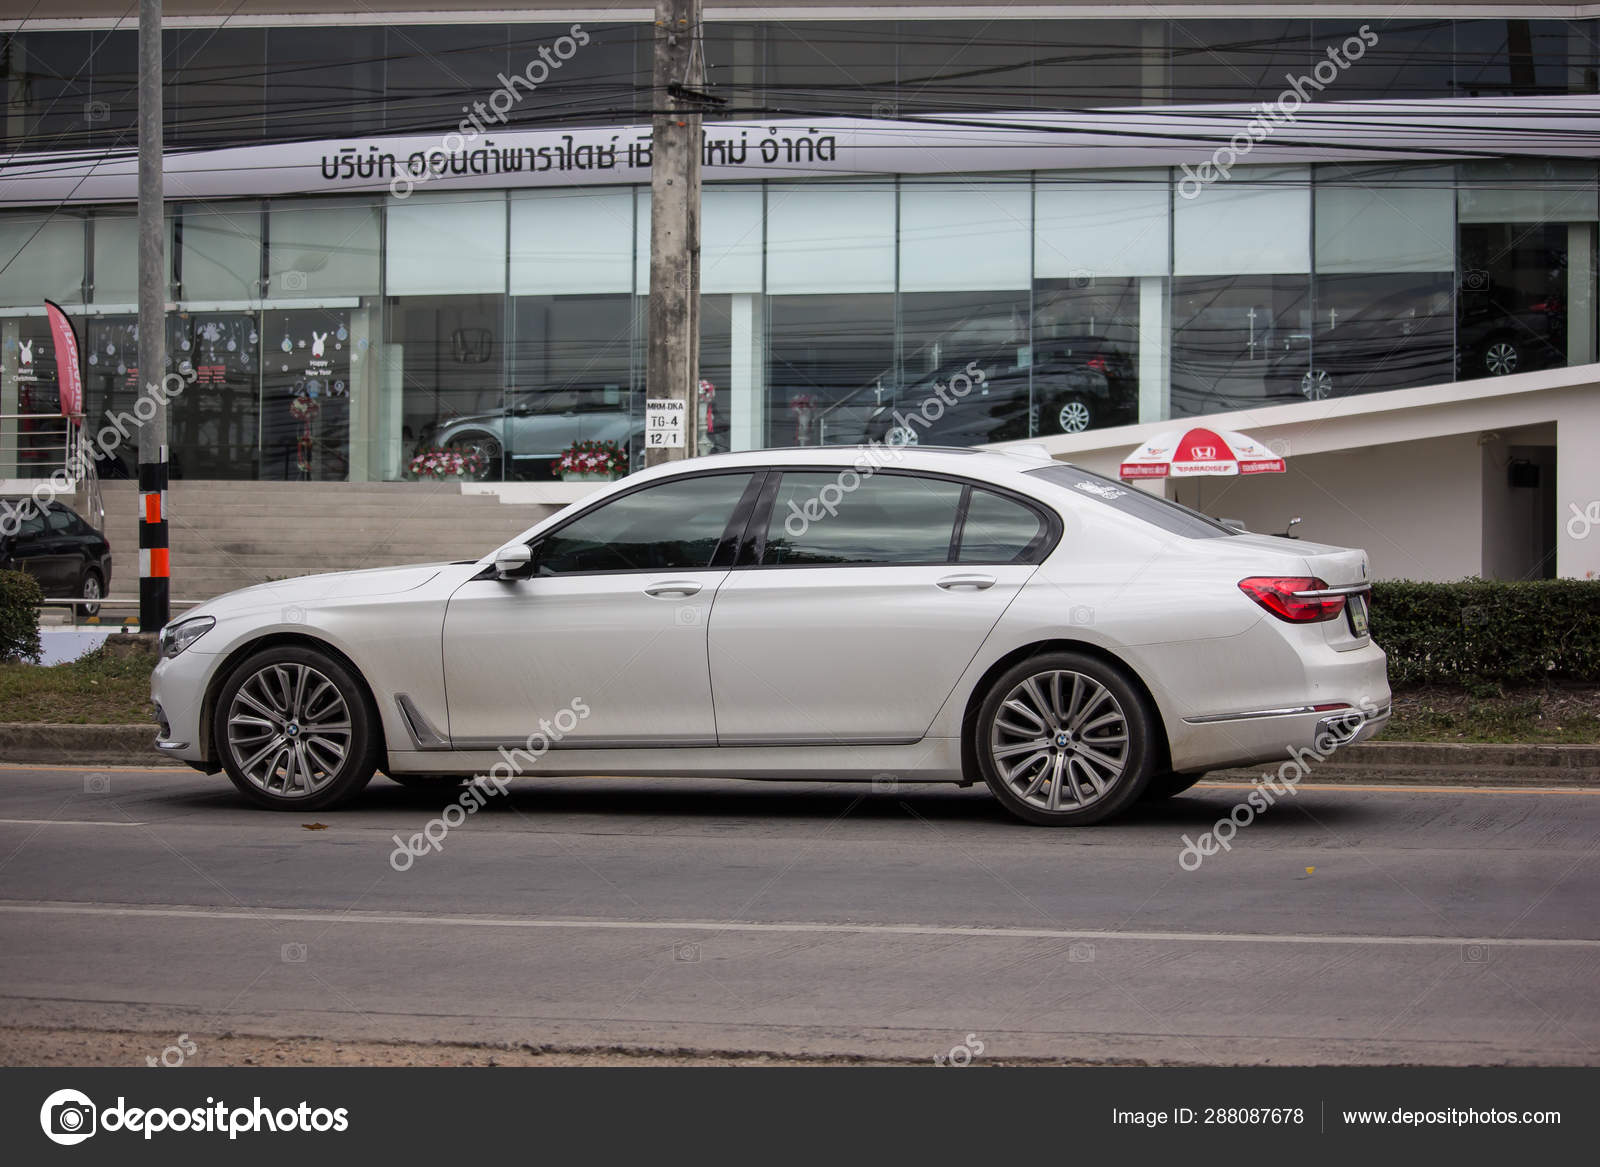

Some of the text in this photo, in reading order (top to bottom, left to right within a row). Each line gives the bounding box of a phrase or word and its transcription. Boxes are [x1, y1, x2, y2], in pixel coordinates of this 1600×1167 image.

[322, 146, 396, 179] บริษัท
[760, 127, 836, 163] จำกัด
